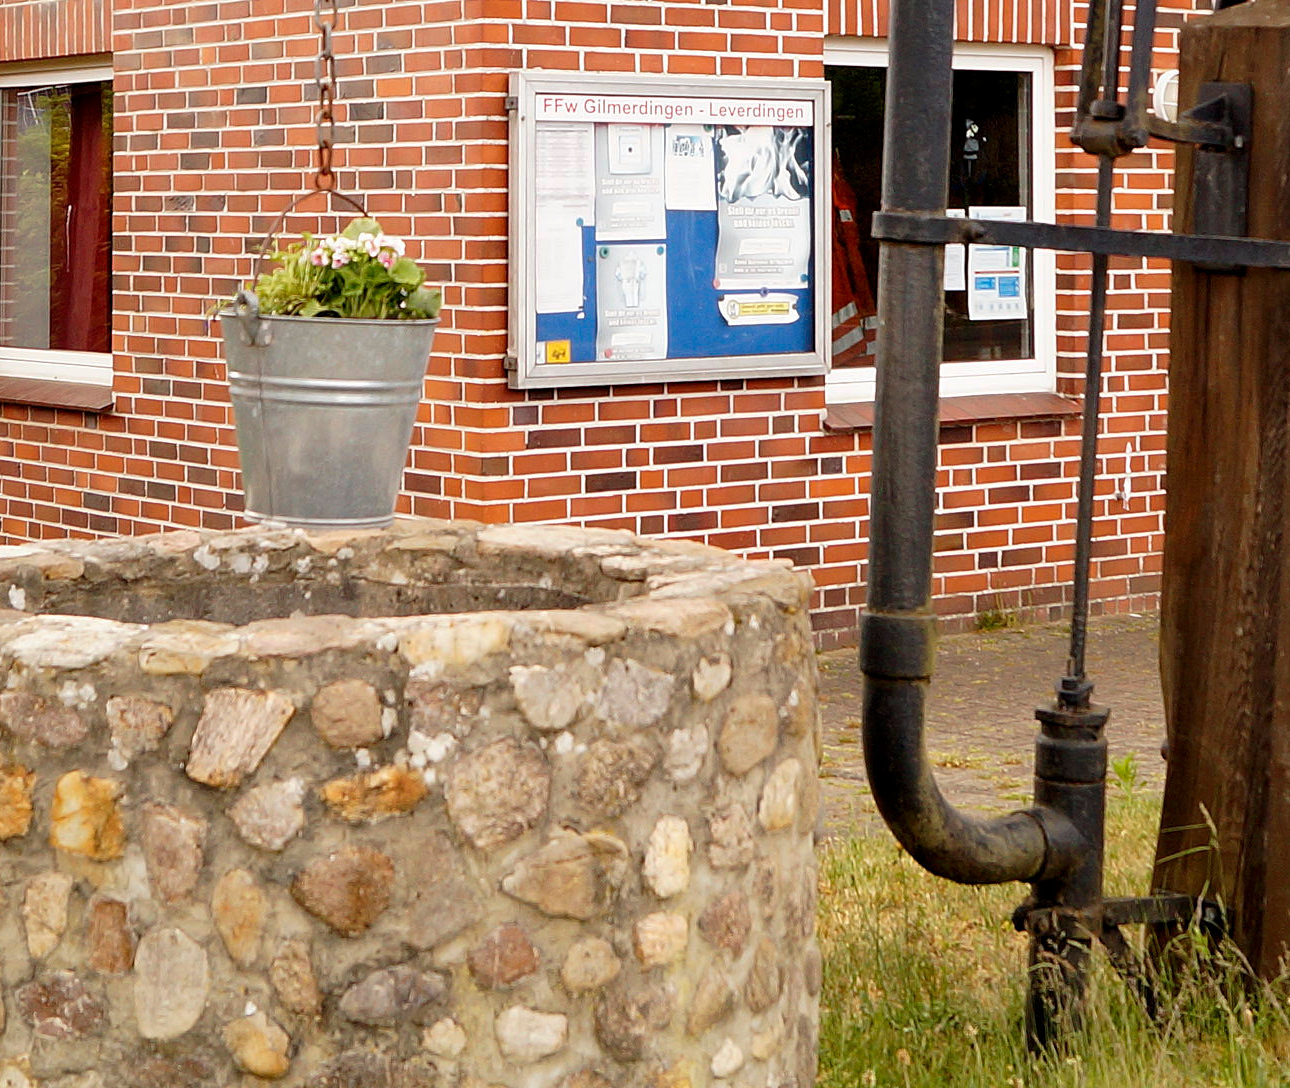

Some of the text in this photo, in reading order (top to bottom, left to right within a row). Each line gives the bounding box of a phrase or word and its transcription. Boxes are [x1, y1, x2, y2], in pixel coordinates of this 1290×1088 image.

[543, 98, 578, 113] FFw
[583, 98, 693, 119] Gilmerdingen
[709, 102, 804, 122] Leverdingen
